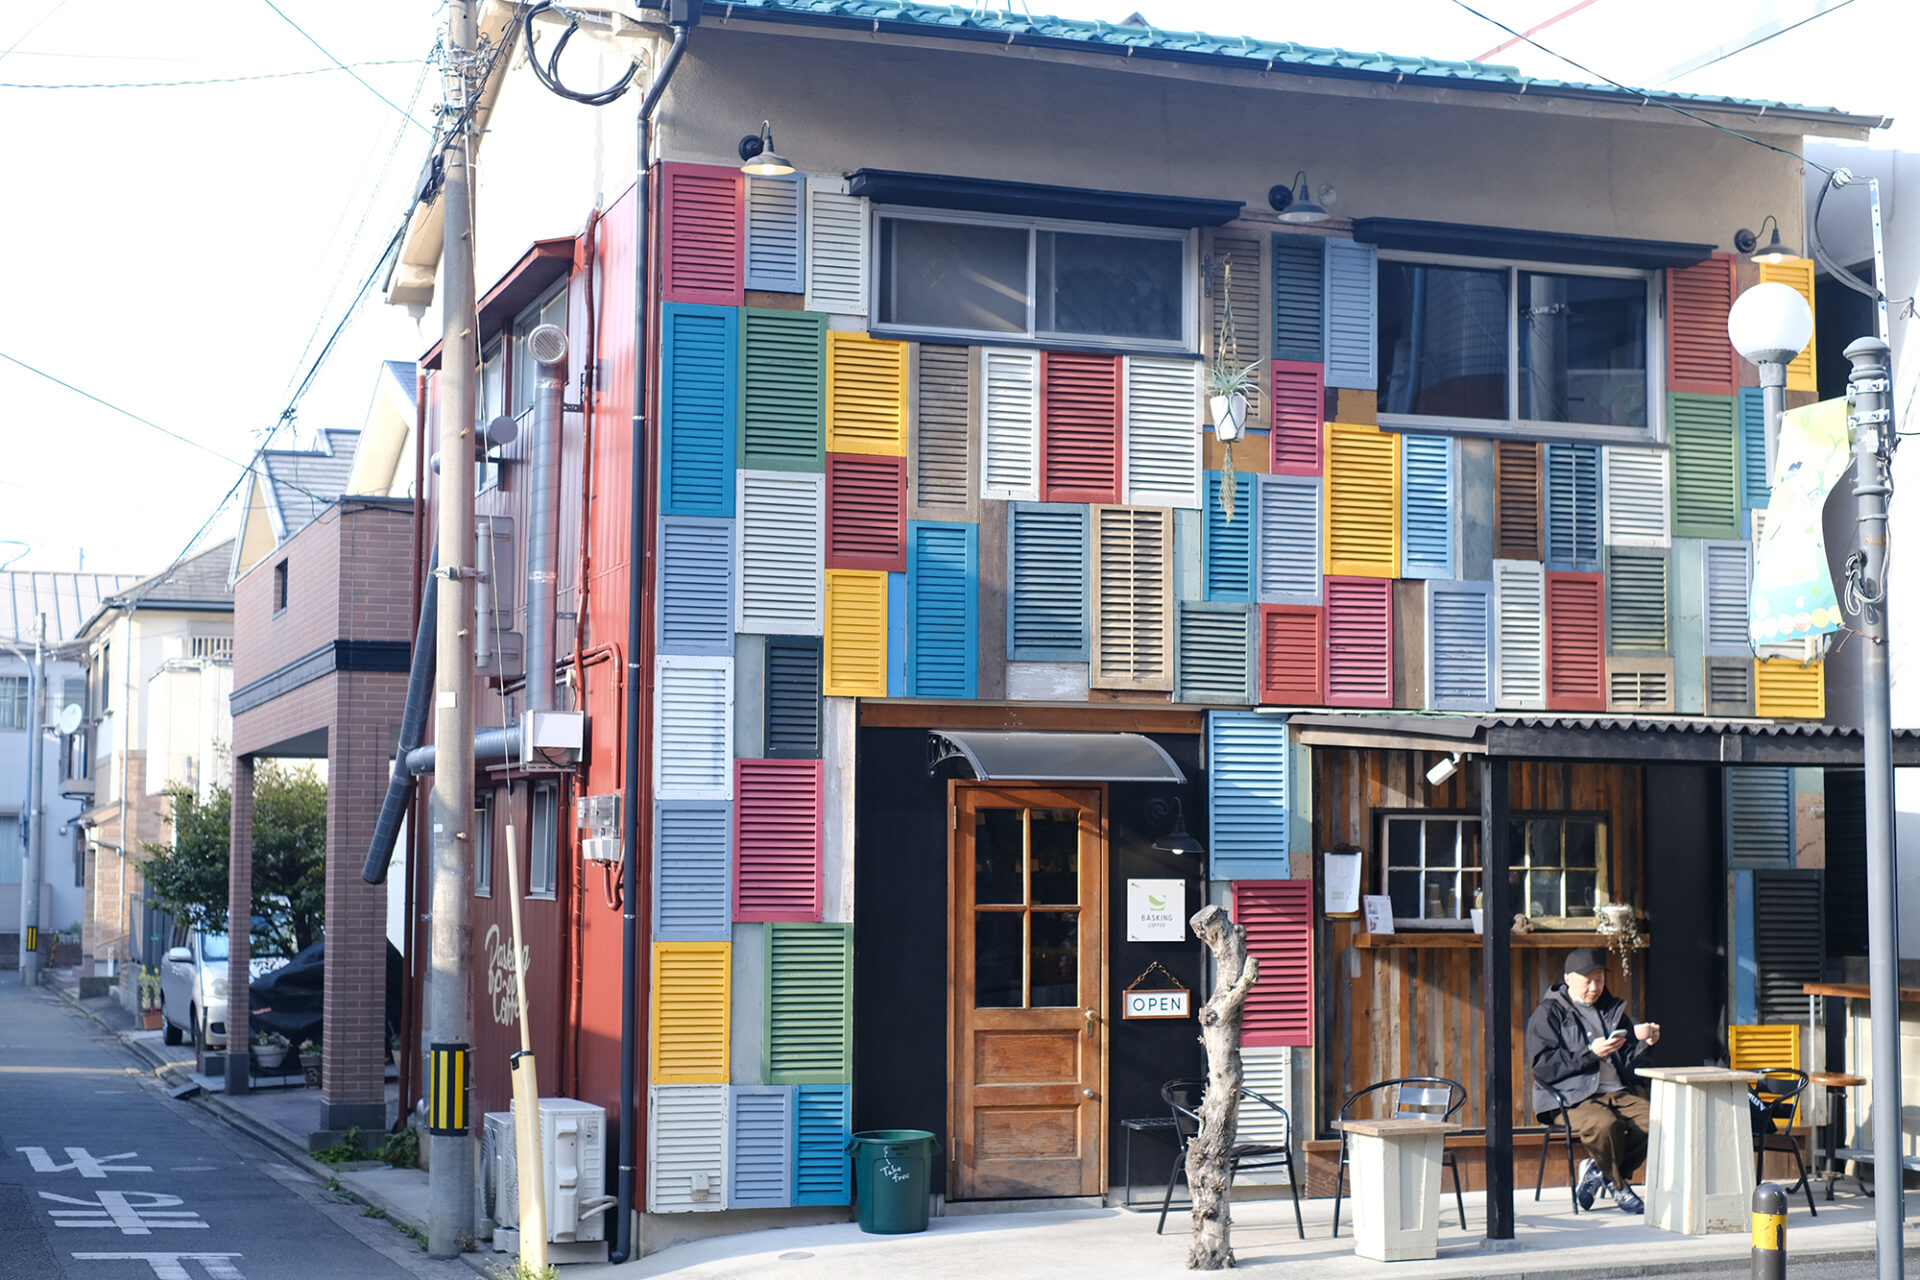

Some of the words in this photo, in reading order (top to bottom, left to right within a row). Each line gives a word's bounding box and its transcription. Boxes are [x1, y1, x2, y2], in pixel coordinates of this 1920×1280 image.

[1141, 914, 1173, 922] BASKING
[1132, 997, 1181, 1012] OPEN
[880, 1164, 902, 1177] Take
